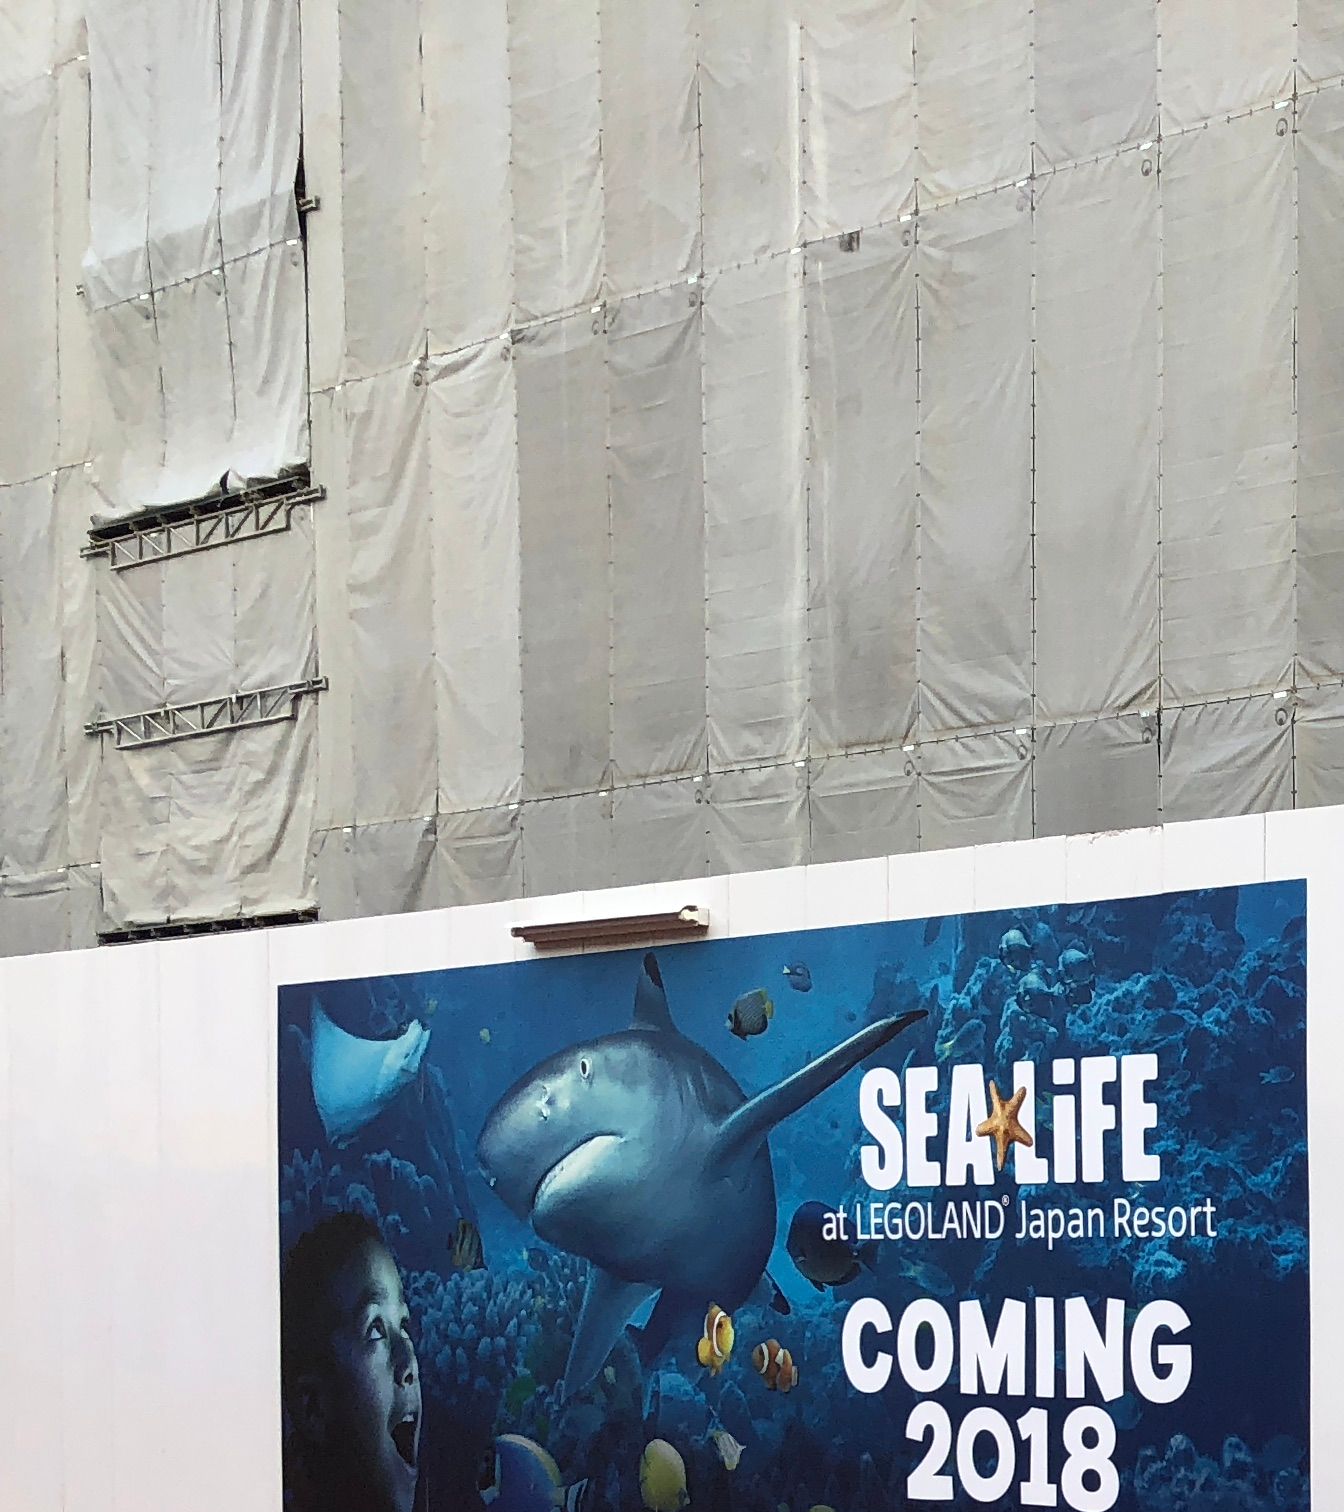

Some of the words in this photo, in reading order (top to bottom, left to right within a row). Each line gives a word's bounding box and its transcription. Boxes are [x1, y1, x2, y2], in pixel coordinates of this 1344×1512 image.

[859, 1063, 995, 1190] SEA
[822, 1210, 849, 1242] at
[1015, 1199, 1105, 1250] Japan
[1113, 1197, 1218, 1239] Resort
[842, 1296, 1193, 1403] COMING
[905, 1400, 1120, 1512] 2018
